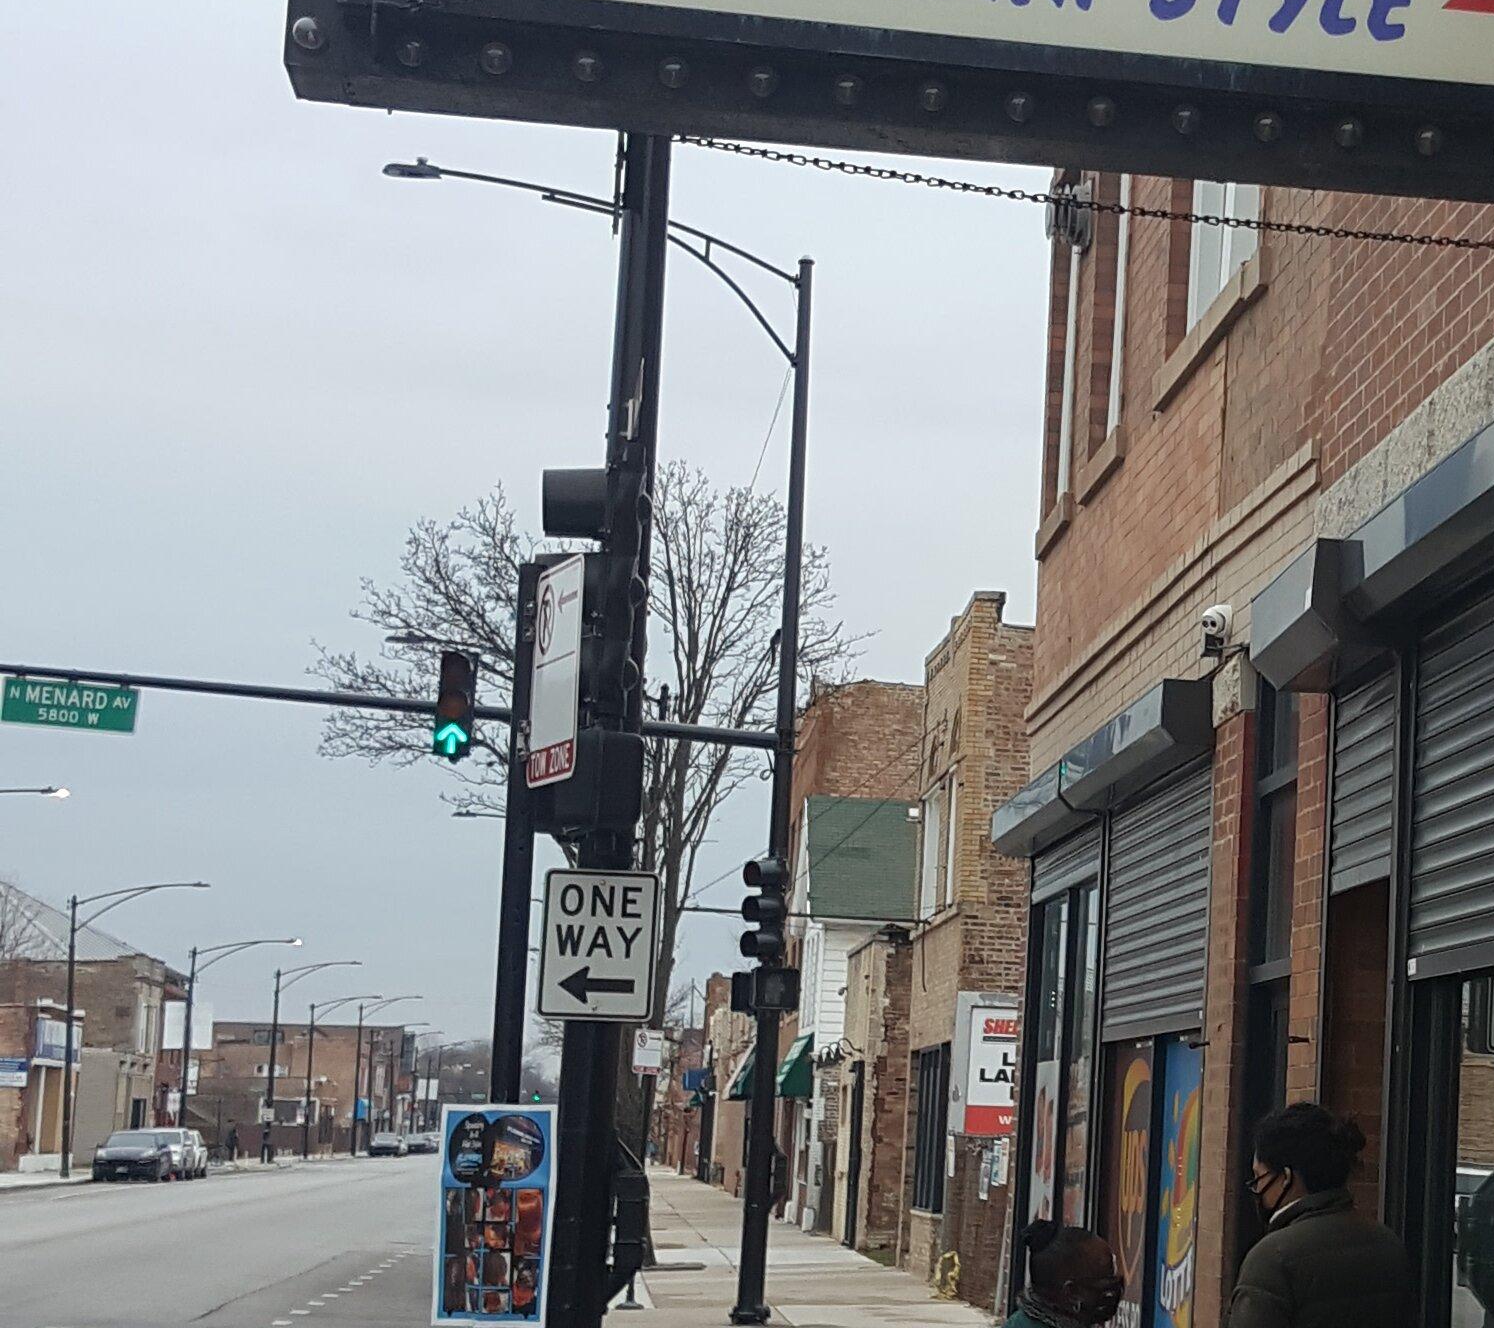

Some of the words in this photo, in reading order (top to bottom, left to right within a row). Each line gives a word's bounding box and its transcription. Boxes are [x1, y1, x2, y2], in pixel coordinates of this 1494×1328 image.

[9, 685, 21, 699] N
[25, 684, 108, 710] MENARD
[112, 695, 132, 710] AV
[37, 707, 79, 724] 5800
[87, 712, 100, 726] W
[530, 751, 547, 780] TOW
[549, 742, 571, 774] ZONE
[560, 883, 643, 919] ONE
[556, 924, 643, 959] WAY
